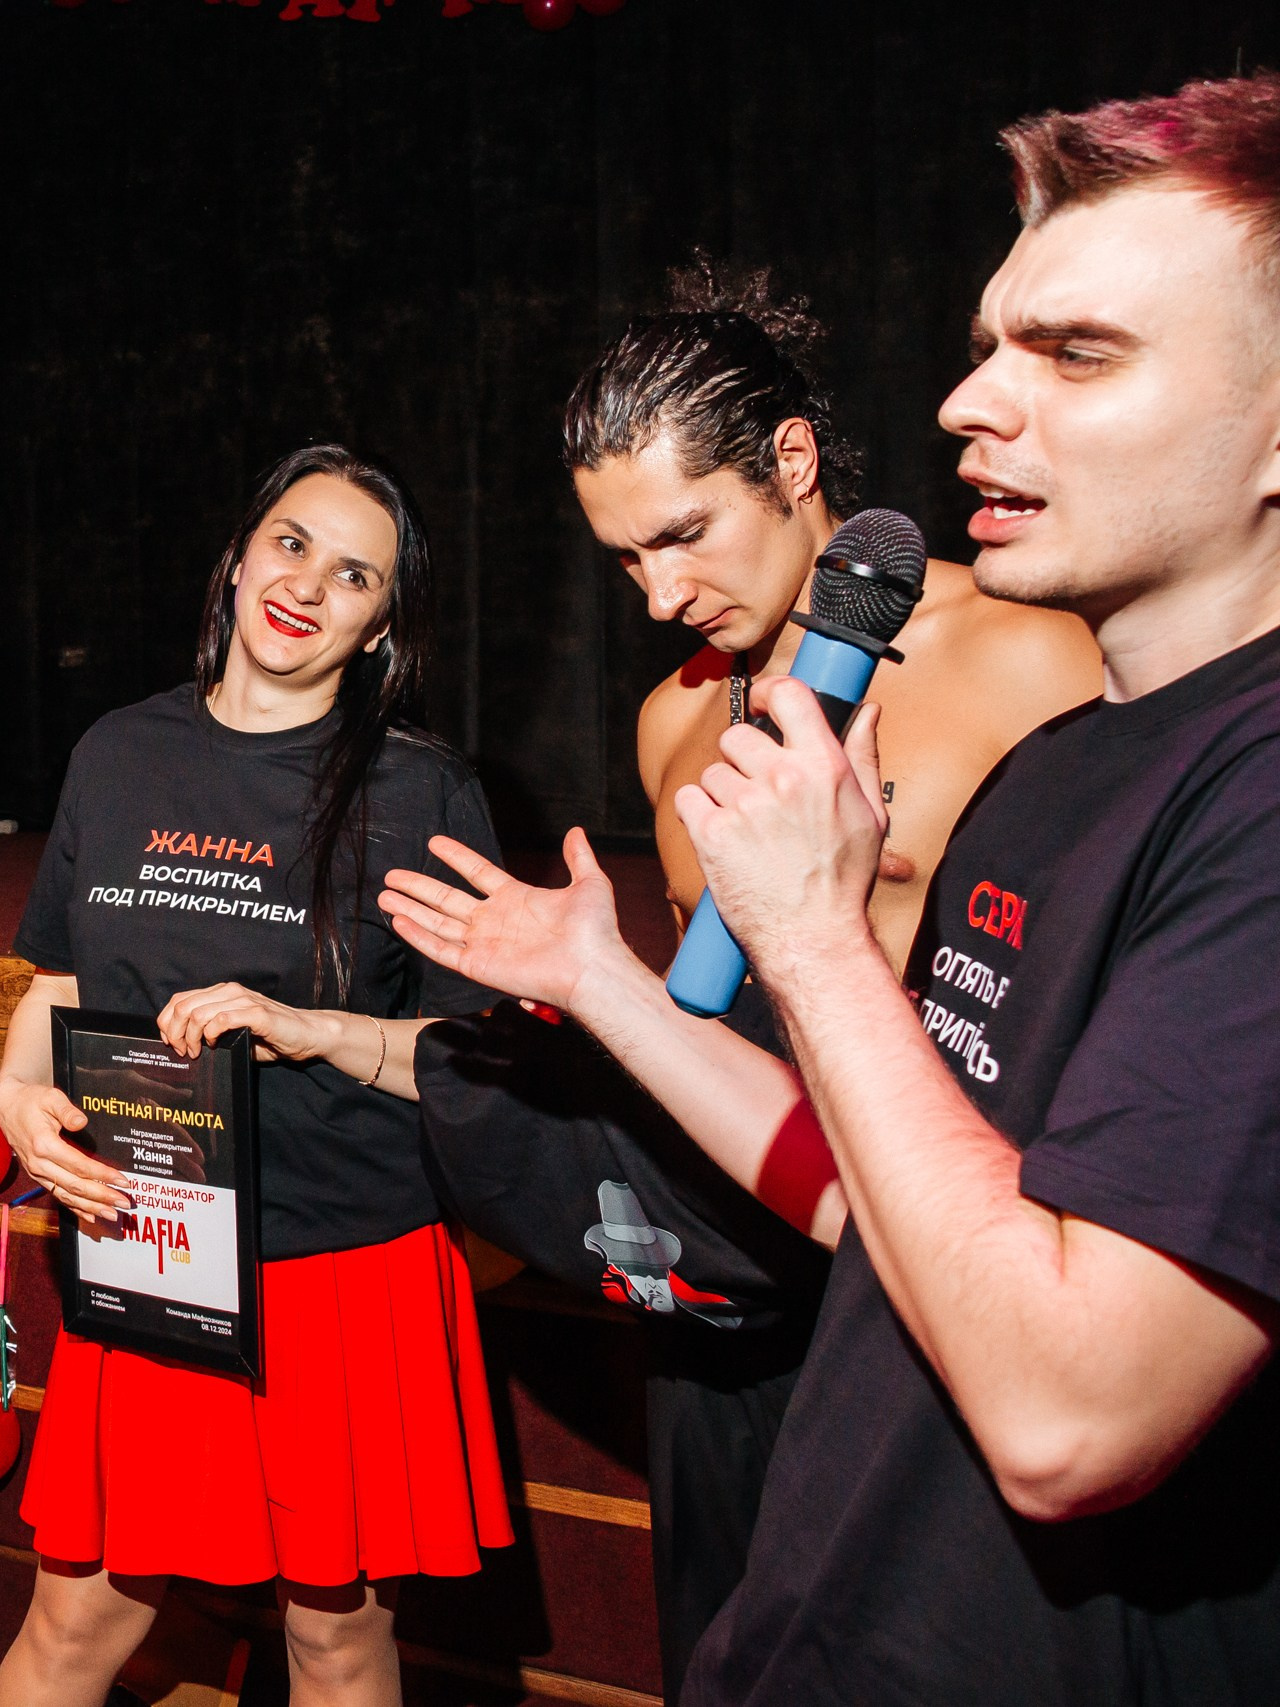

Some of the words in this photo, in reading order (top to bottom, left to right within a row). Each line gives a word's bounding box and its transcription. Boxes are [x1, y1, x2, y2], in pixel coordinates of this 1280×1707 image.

[144, 829, 274, 867] ЖАННА
[139, 864, 262, 893] ВОСПИТКА
[87, 886, 133, 907] ПОД
[138, 889, 307, 925] ПРИКРЫТИЕМ
[932, 946, 996, 1004] ОПЯТЬ
[111, 1055, 133, 1063] которые
[128, 1050, 150, 1059] Спасибо
[82, 1095, 153, 1120] ПОЧЁТНАЯ
[155, 1106, 224, 1131] ГРАМОТА
[113, 1135, 141, 1146] воспитка
[142, 1139, 153, 1148] под
[154, 1141, 193, 1154] прикрытием
[130, 1128, 174, 1142] Награждается
[132, 1146, 173, 1166] Жанна
[139, 1165, 173, 1176] номинации
[141, 1181, 215, 1204] ОРГАНИЗАТОР
[135, 1194, 184, 1212] ВЕДУЩАЯ
[122, 1212, 191, 1274] MAFIA
[170, 1249, 191, 1264] CLUB
[165, 1307, 191, 1319] Команда
